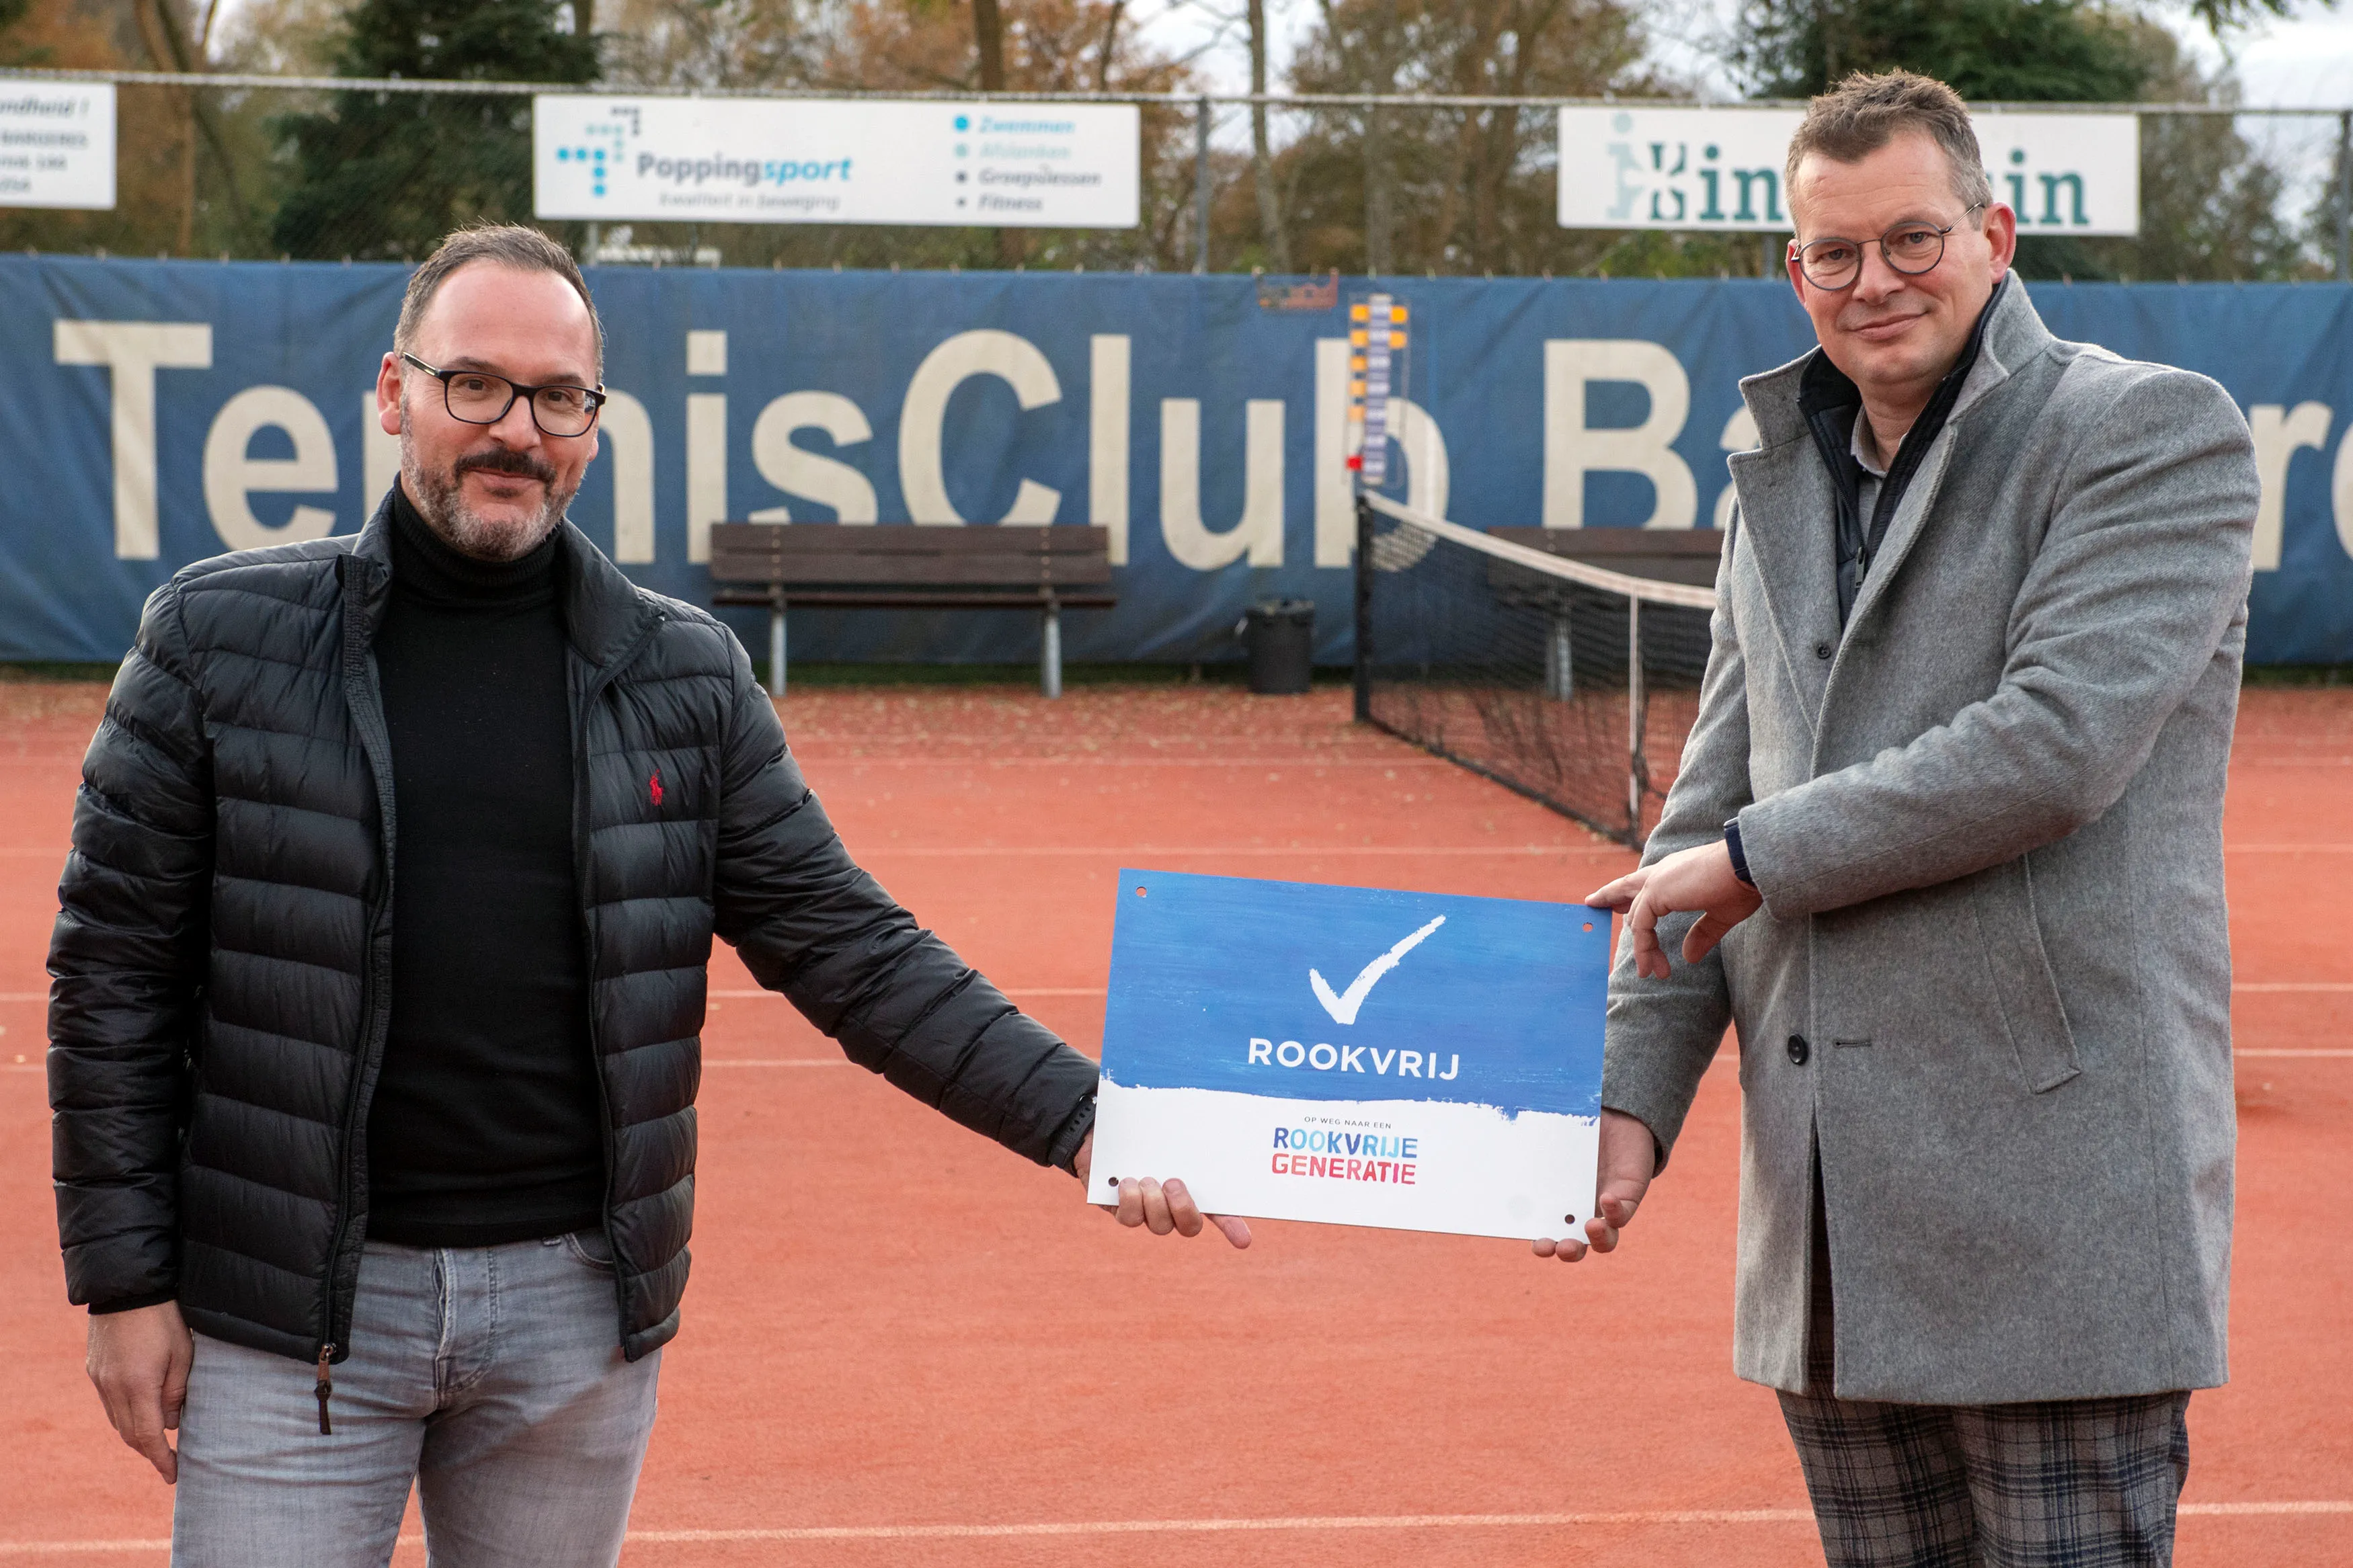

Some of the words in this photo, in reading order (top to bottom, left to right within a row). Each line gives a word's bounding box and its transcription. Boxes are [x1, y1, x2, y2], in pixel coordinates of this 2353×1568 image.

[979, 116, 1075, 133] Zwemmen
[636, 151, 852, 188] Poppingsport
[978, 194, 1043, 212] Fitness
[1248, 1037, 1460, 1081] ROOKVRIJ
[1320, 1117, 1341, 1125] WEG
[1344, 1119, 1370, 1128] NAAR
[1273, 1126, 1418, 1159] ROOKVRIJE
[1271, 1153, 1417, 1185] GENERATIE
